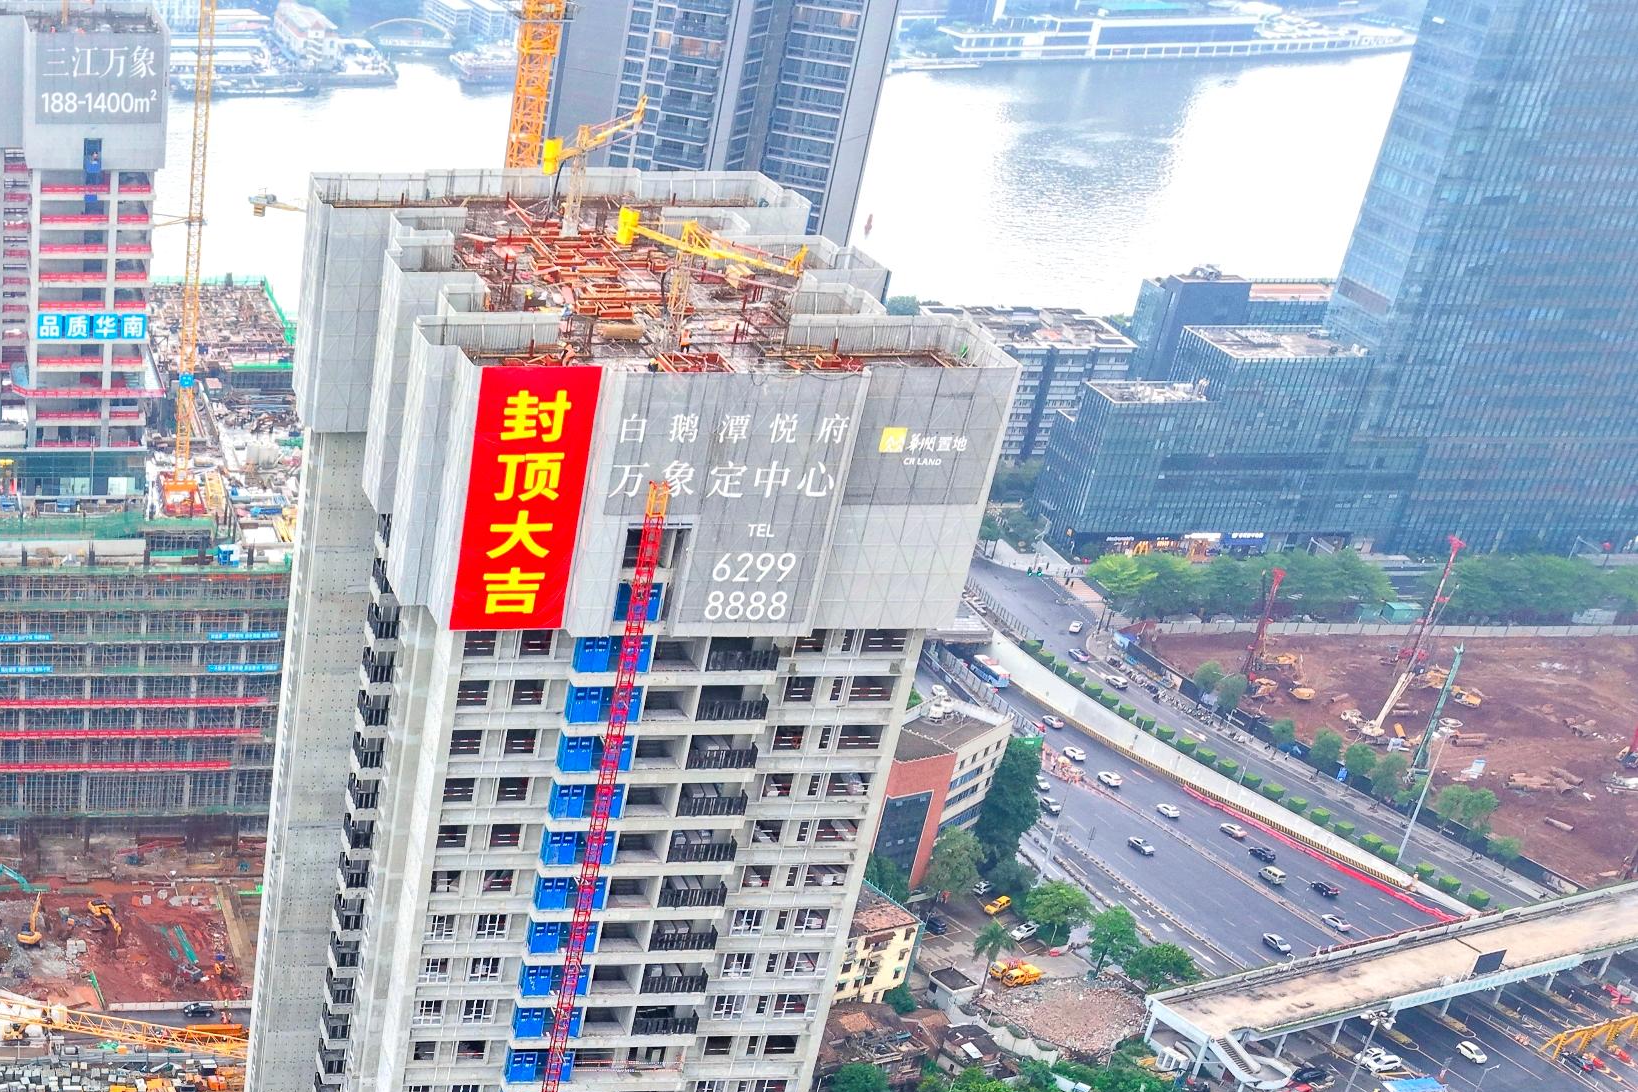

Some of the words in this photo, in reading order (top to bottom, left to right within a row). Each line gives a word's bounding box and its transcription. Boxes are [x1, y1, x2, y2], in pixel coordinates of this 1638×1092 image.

[42, 45, 156, 78] 三江万象
[40, 315, 143, 337] 品质华南
[619, 413, 850, 444] 白鹅潭悦府
[917, 457, 941, 466] LAND
[608, 461, 835, 498] 万象定中心
[483, 390, 571, 614] 封顶大吉
[748, 524, 775, 538] TEL
[712, 552, 796, 582] 6299
[704, 590, 788, 620] 8888
